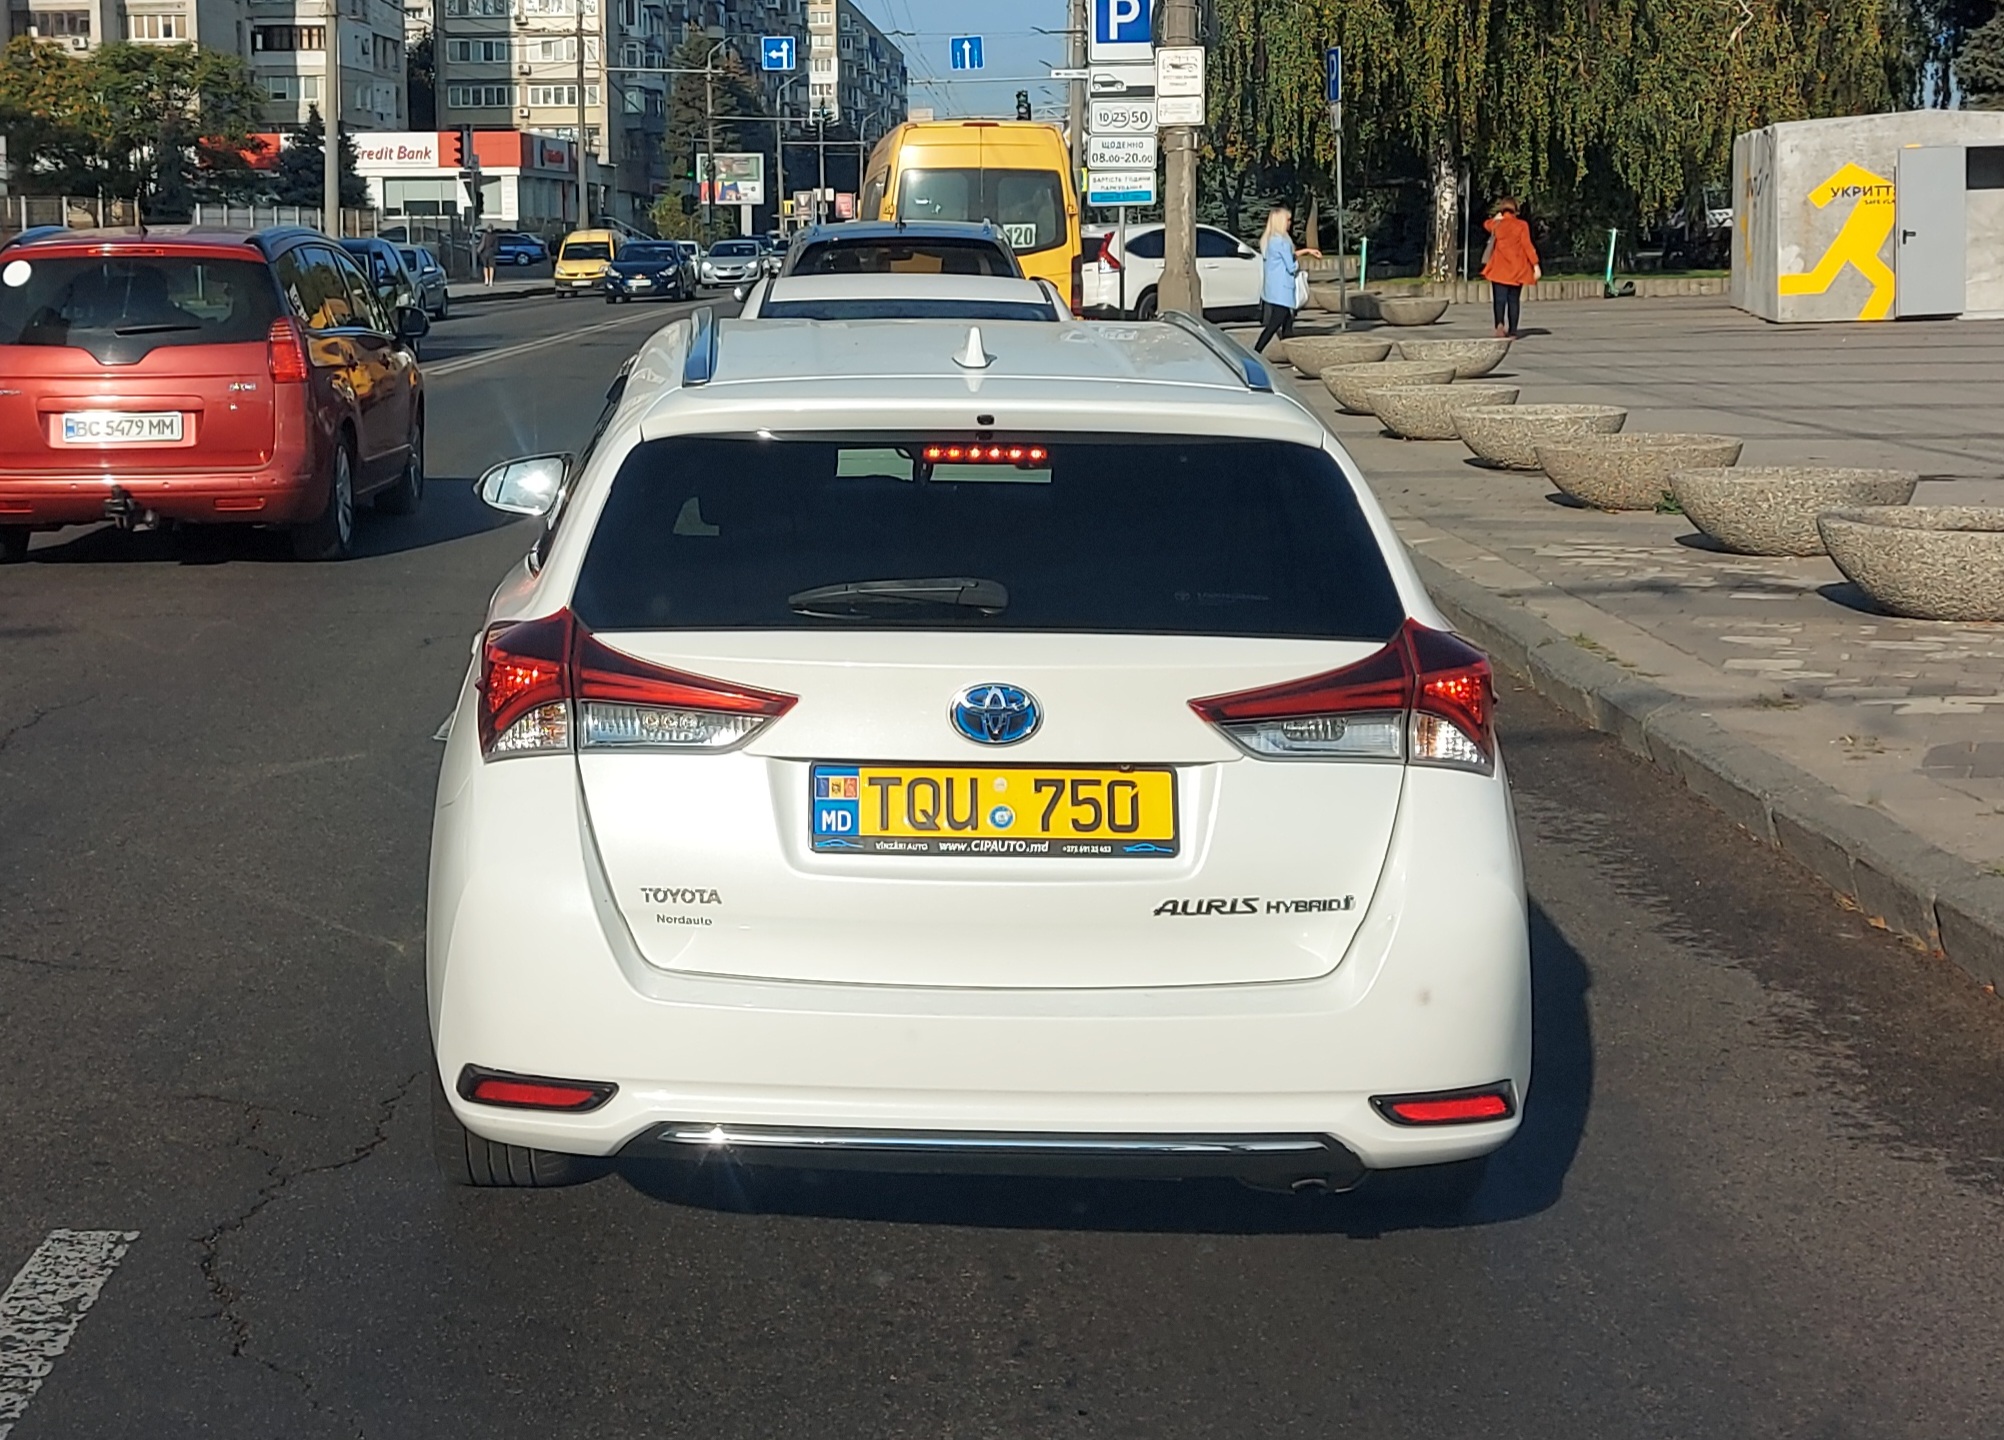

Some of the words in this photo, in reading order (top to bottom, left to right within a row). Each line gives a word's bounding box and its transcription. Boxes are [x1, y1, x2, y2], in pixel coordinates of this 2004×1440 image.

[1109, 0, 1140, 40] P
[1329, 54, 1337, 99] P
[1099, 112, 1110, 121] 10
[1113, 112, 1127, 121] 25
[1131, 111, 1148, 123] 50
[358, 147, 394, 160] redit
[397, 145, 432, 160] Bank
[1101, 141, 1144, 149] ЩОДЕННО
[1830, 185, 1895, 198] УКРИТТ
[75, 421, 100, 437] BC
[105, 419, 144, 436] 5479
[149, 418, 174, 435] MM
[868, 777, 978, 832] TQU
[1034, 778, 1139, 833] 750
[821, 809, 851, 832] MD
[939, 840, 1049, 853] www.CIPAUTO.md
[640, 887, 722, 904] TOYOTA
[1153, 897, 1259, 916] AURIS
[1266, 899, 1341, 914] HYBRID
[656, 913, 713, 926] Nordauto
